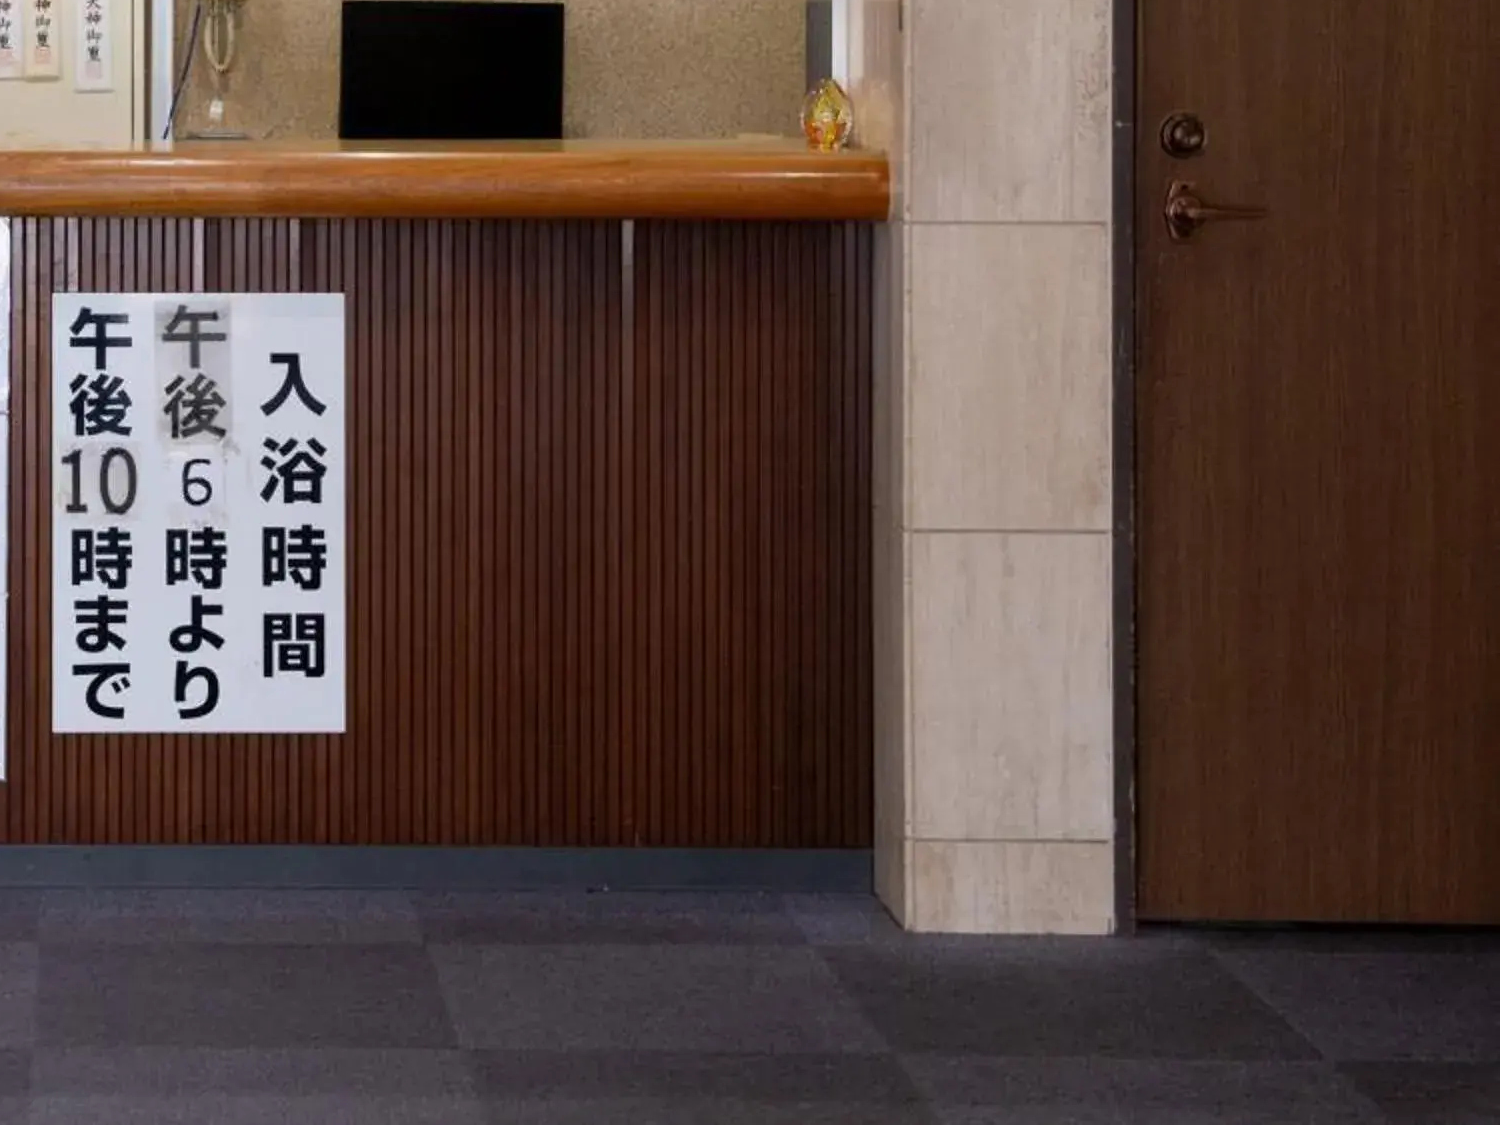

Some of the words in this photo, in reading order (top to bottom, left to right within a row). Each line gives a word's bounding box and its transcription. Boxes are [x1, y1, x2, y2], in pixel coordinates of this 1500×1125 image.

[61, 306, 138, 720] 午後10時まで
[161, 304, 227, 720] 午後6時より
[260, 352, 328, 679] 入浴時間
